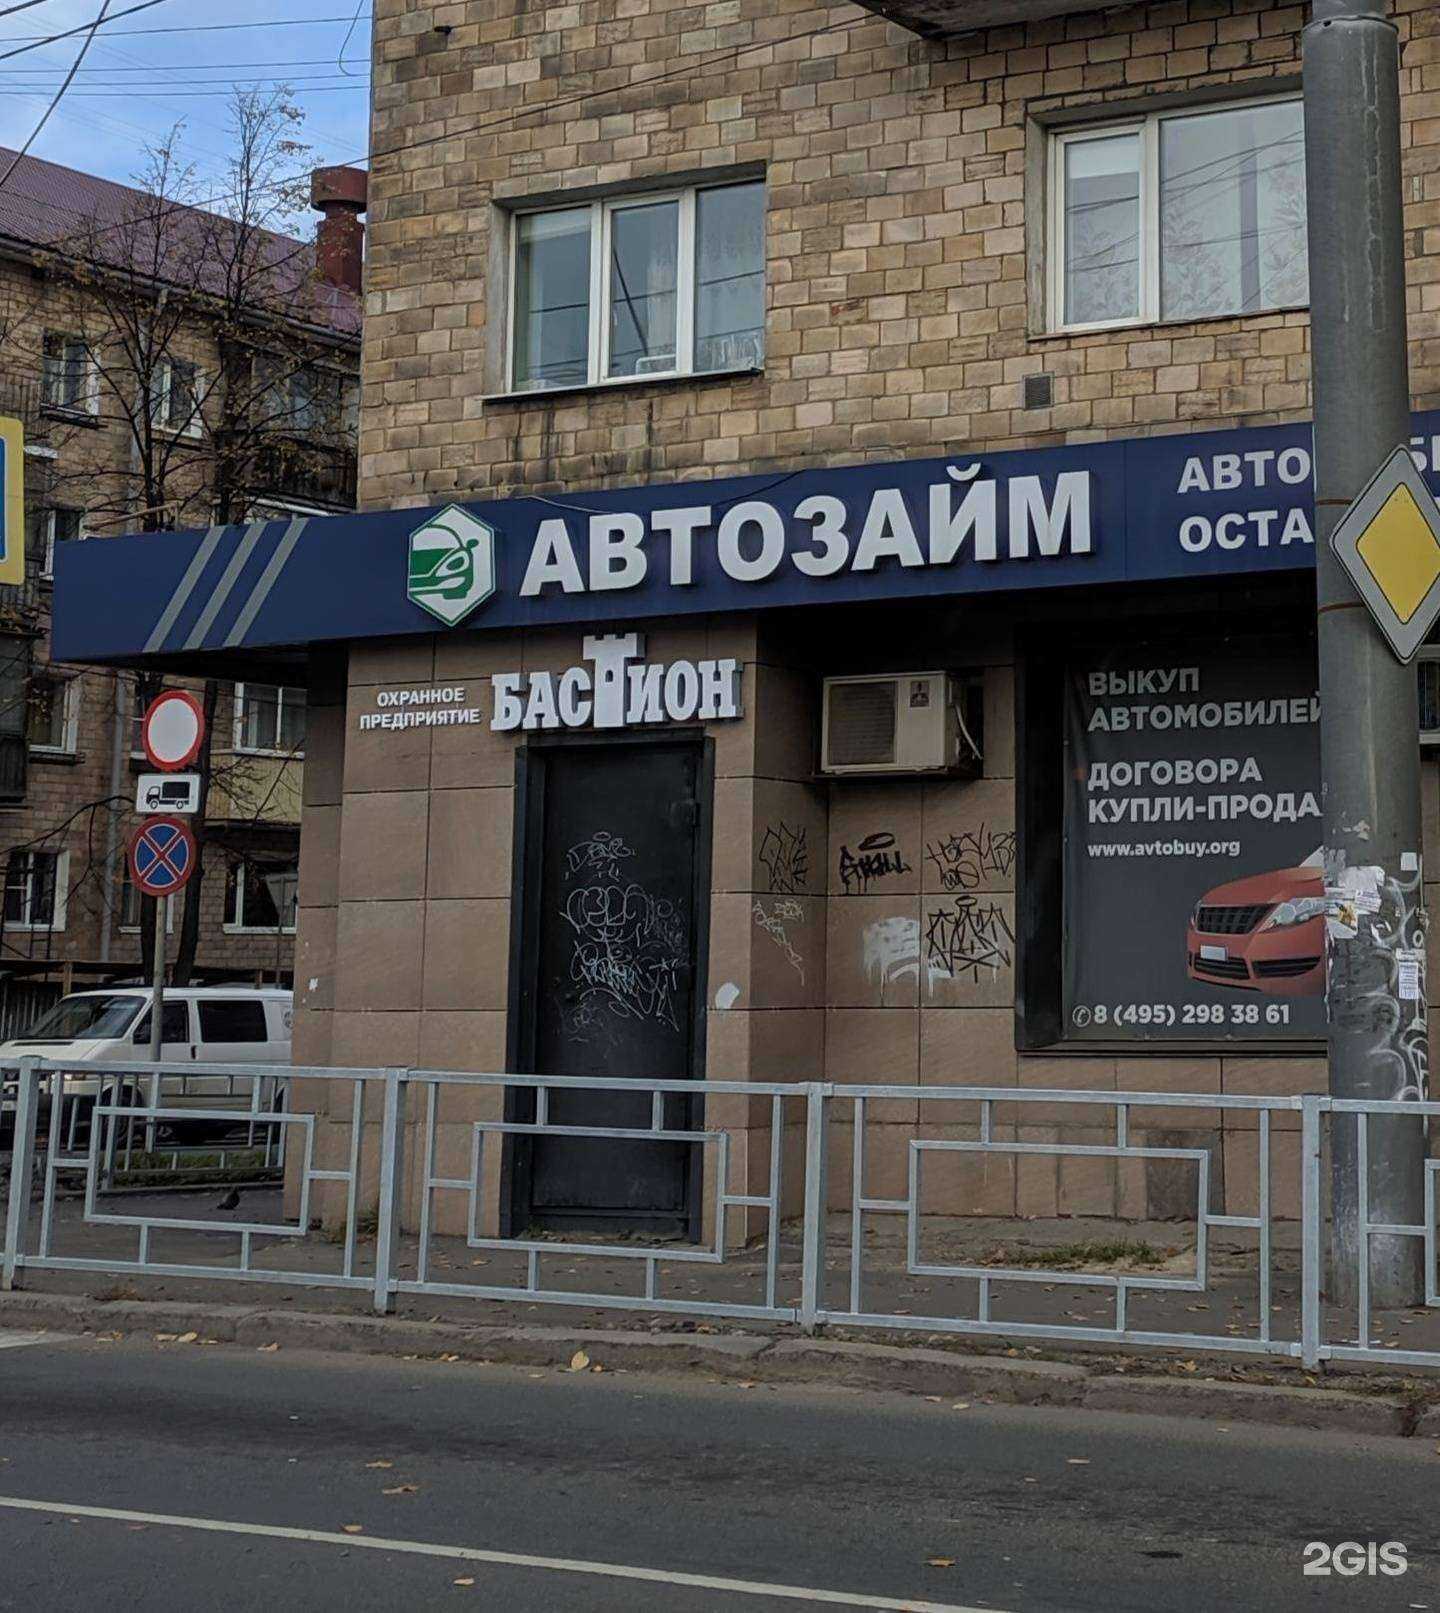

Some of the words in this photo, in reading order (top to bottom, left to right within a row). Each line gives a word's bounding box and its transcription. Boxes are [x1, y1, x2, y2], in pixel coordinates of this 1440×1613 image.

[1177, 447, 1312, 494] АВТО
[519, 462, 1091, 596] АВТОЗАЙМ
[1179, 507, 1315, 552] ОСТА
[377, 687, 465, 707] ОХРАННОЕ
[490, 632, 744, 731] БАСТИОН
[1088, 667, 1199, 696] ВЫКУП
[360, 709, 481, 730] ПРЕДПРИЯТИЕ
[1087, 757, 1263, 791] ДОГОВОРА
[1088, 792, 1323, 824] КУПЛИ-ПРОДА
[1088, 839, 1241, 857] www.avtobuy.org
[1093, 1004, 1108, 1024] 8
[1113, 1004, 1176, 1026] (495)
[1182, 1004, 1225, 1024] 298
[1230, 1004, 1259, 1024] 38
[1265, 1004, 1290, 1024] 61
